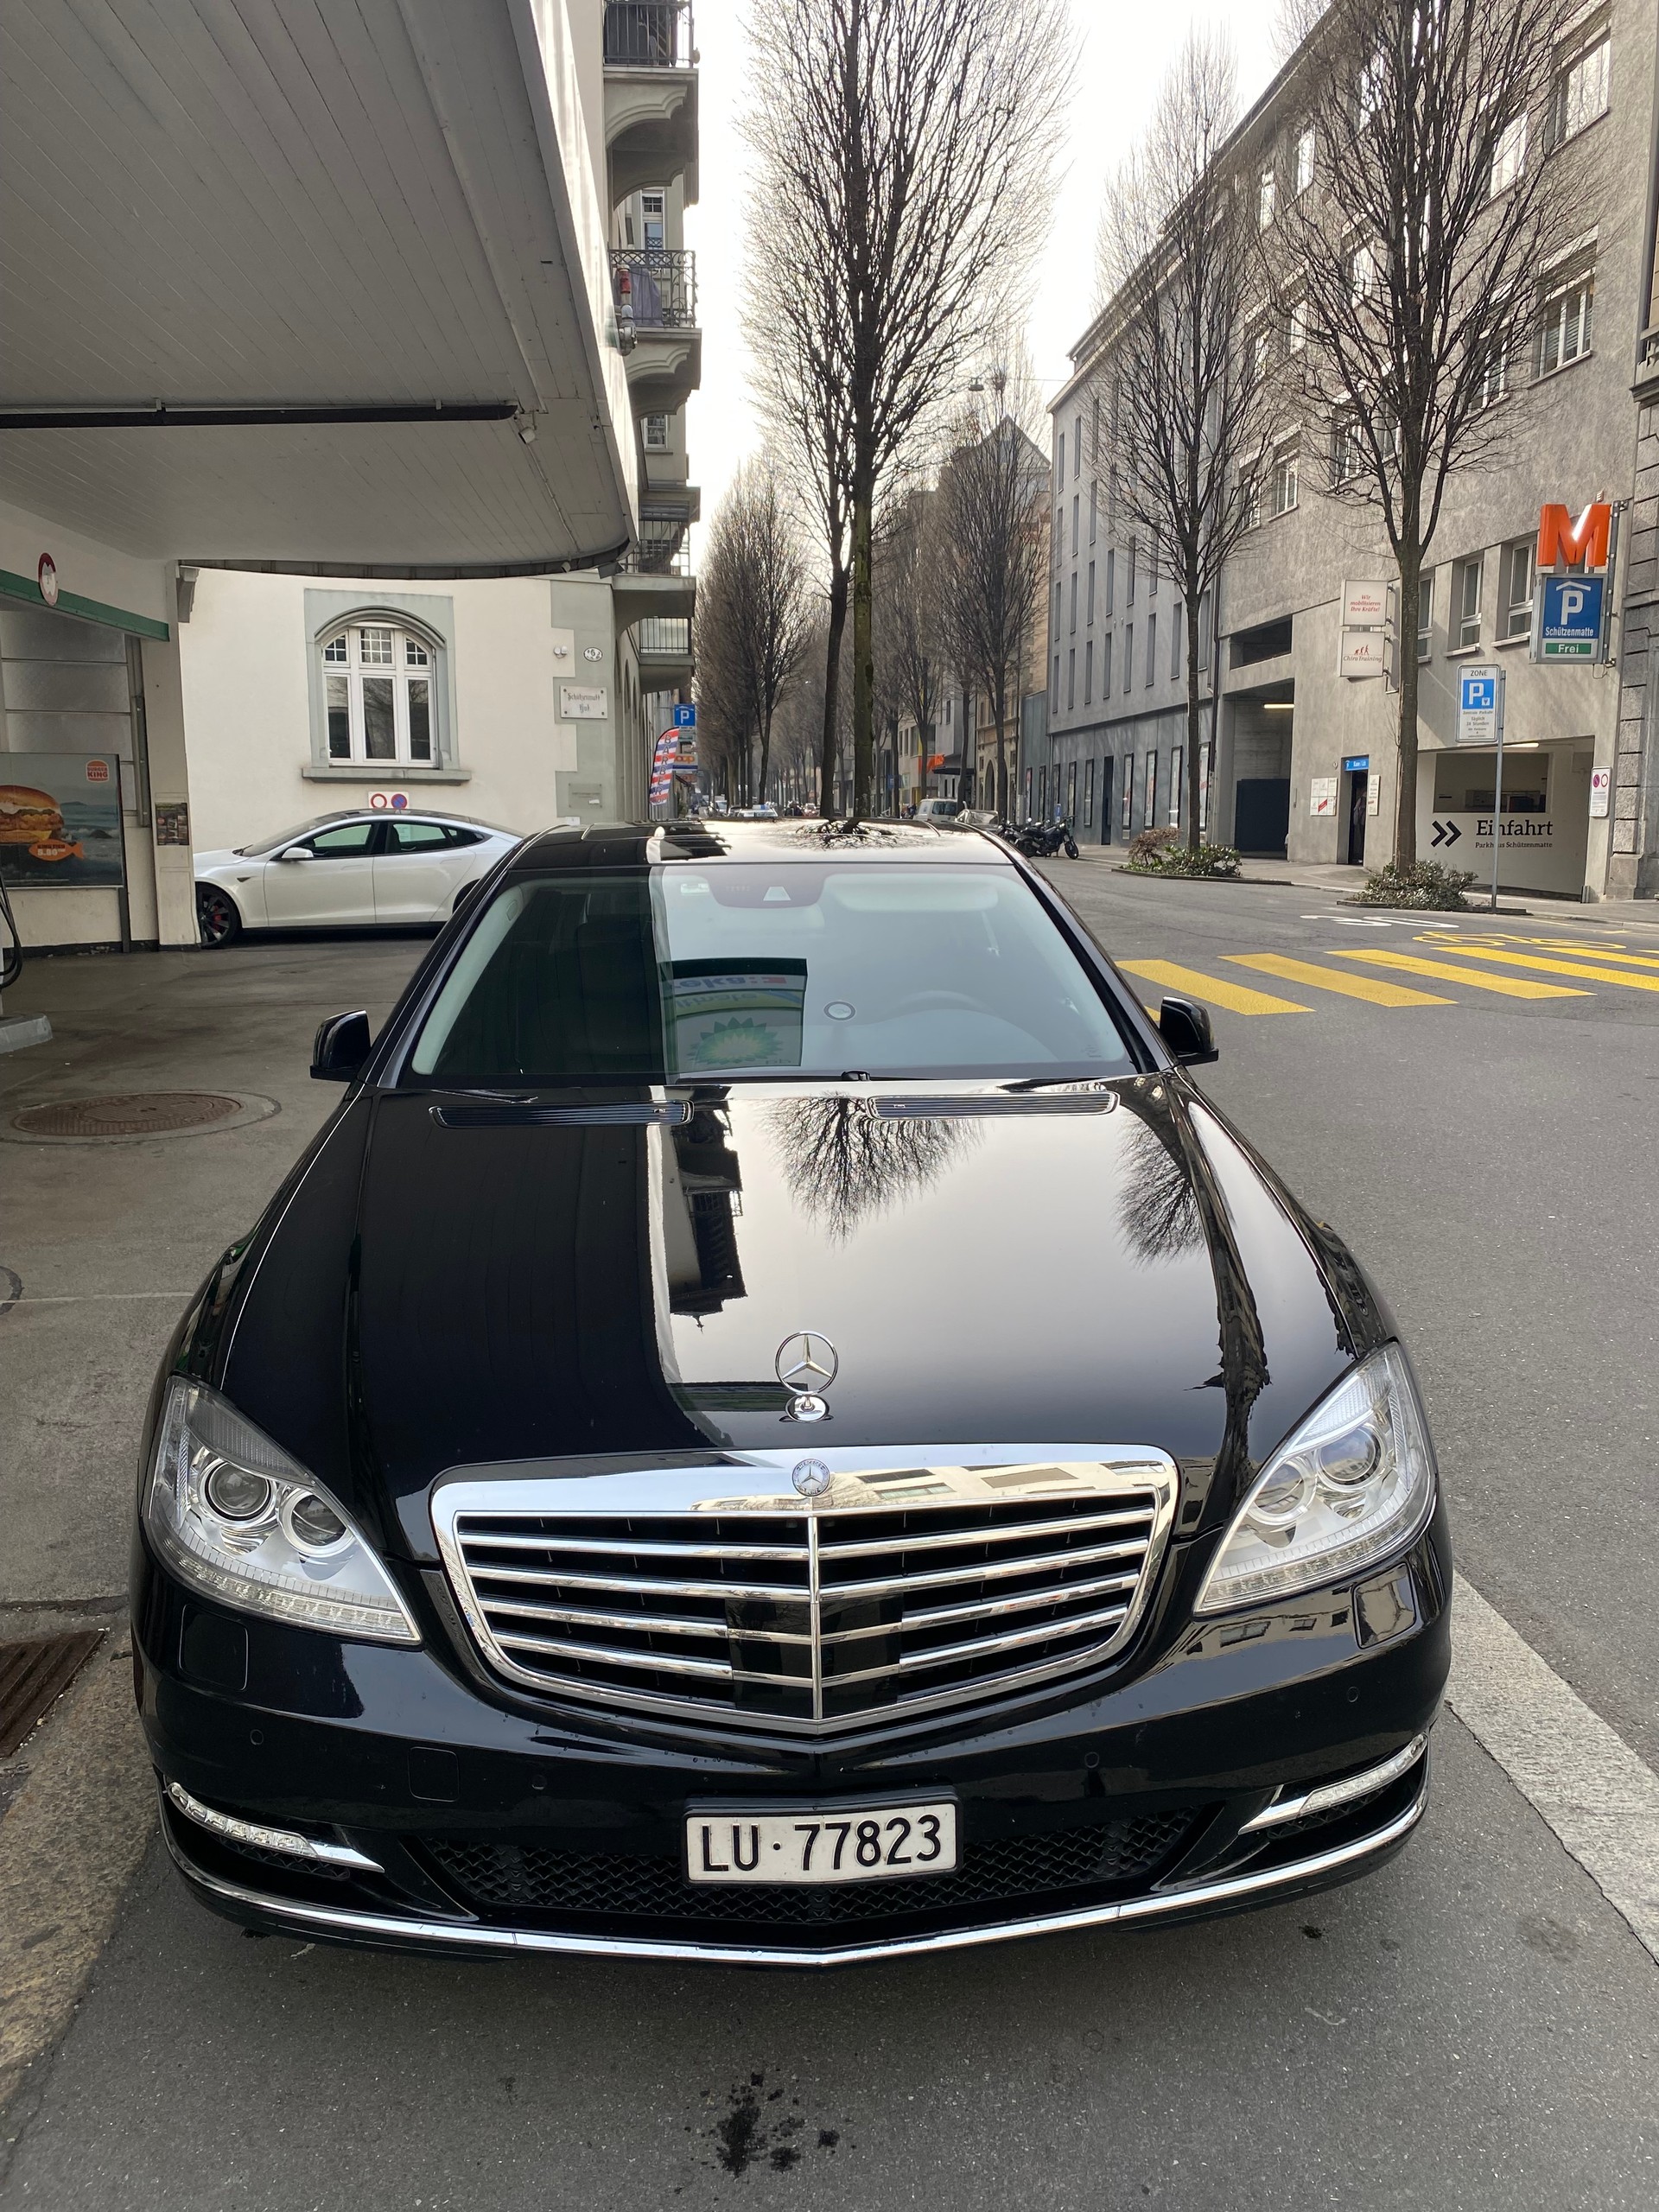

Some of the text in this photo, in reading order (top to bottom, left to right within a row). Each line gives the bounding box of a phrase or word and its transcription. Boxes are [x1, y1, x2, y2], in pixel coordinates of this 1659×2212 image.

[1537, 504, 1611, 567] M
[1560, 590, 1584, 626] P
[1545, 626, 1594, 637] Schützenmatte
[1558, 644, 1580, 653] Frei
[1469, 683, 1484, 704] P
[680, 710, 690, 724] P
[655, 734, 671, 795] BARBER
